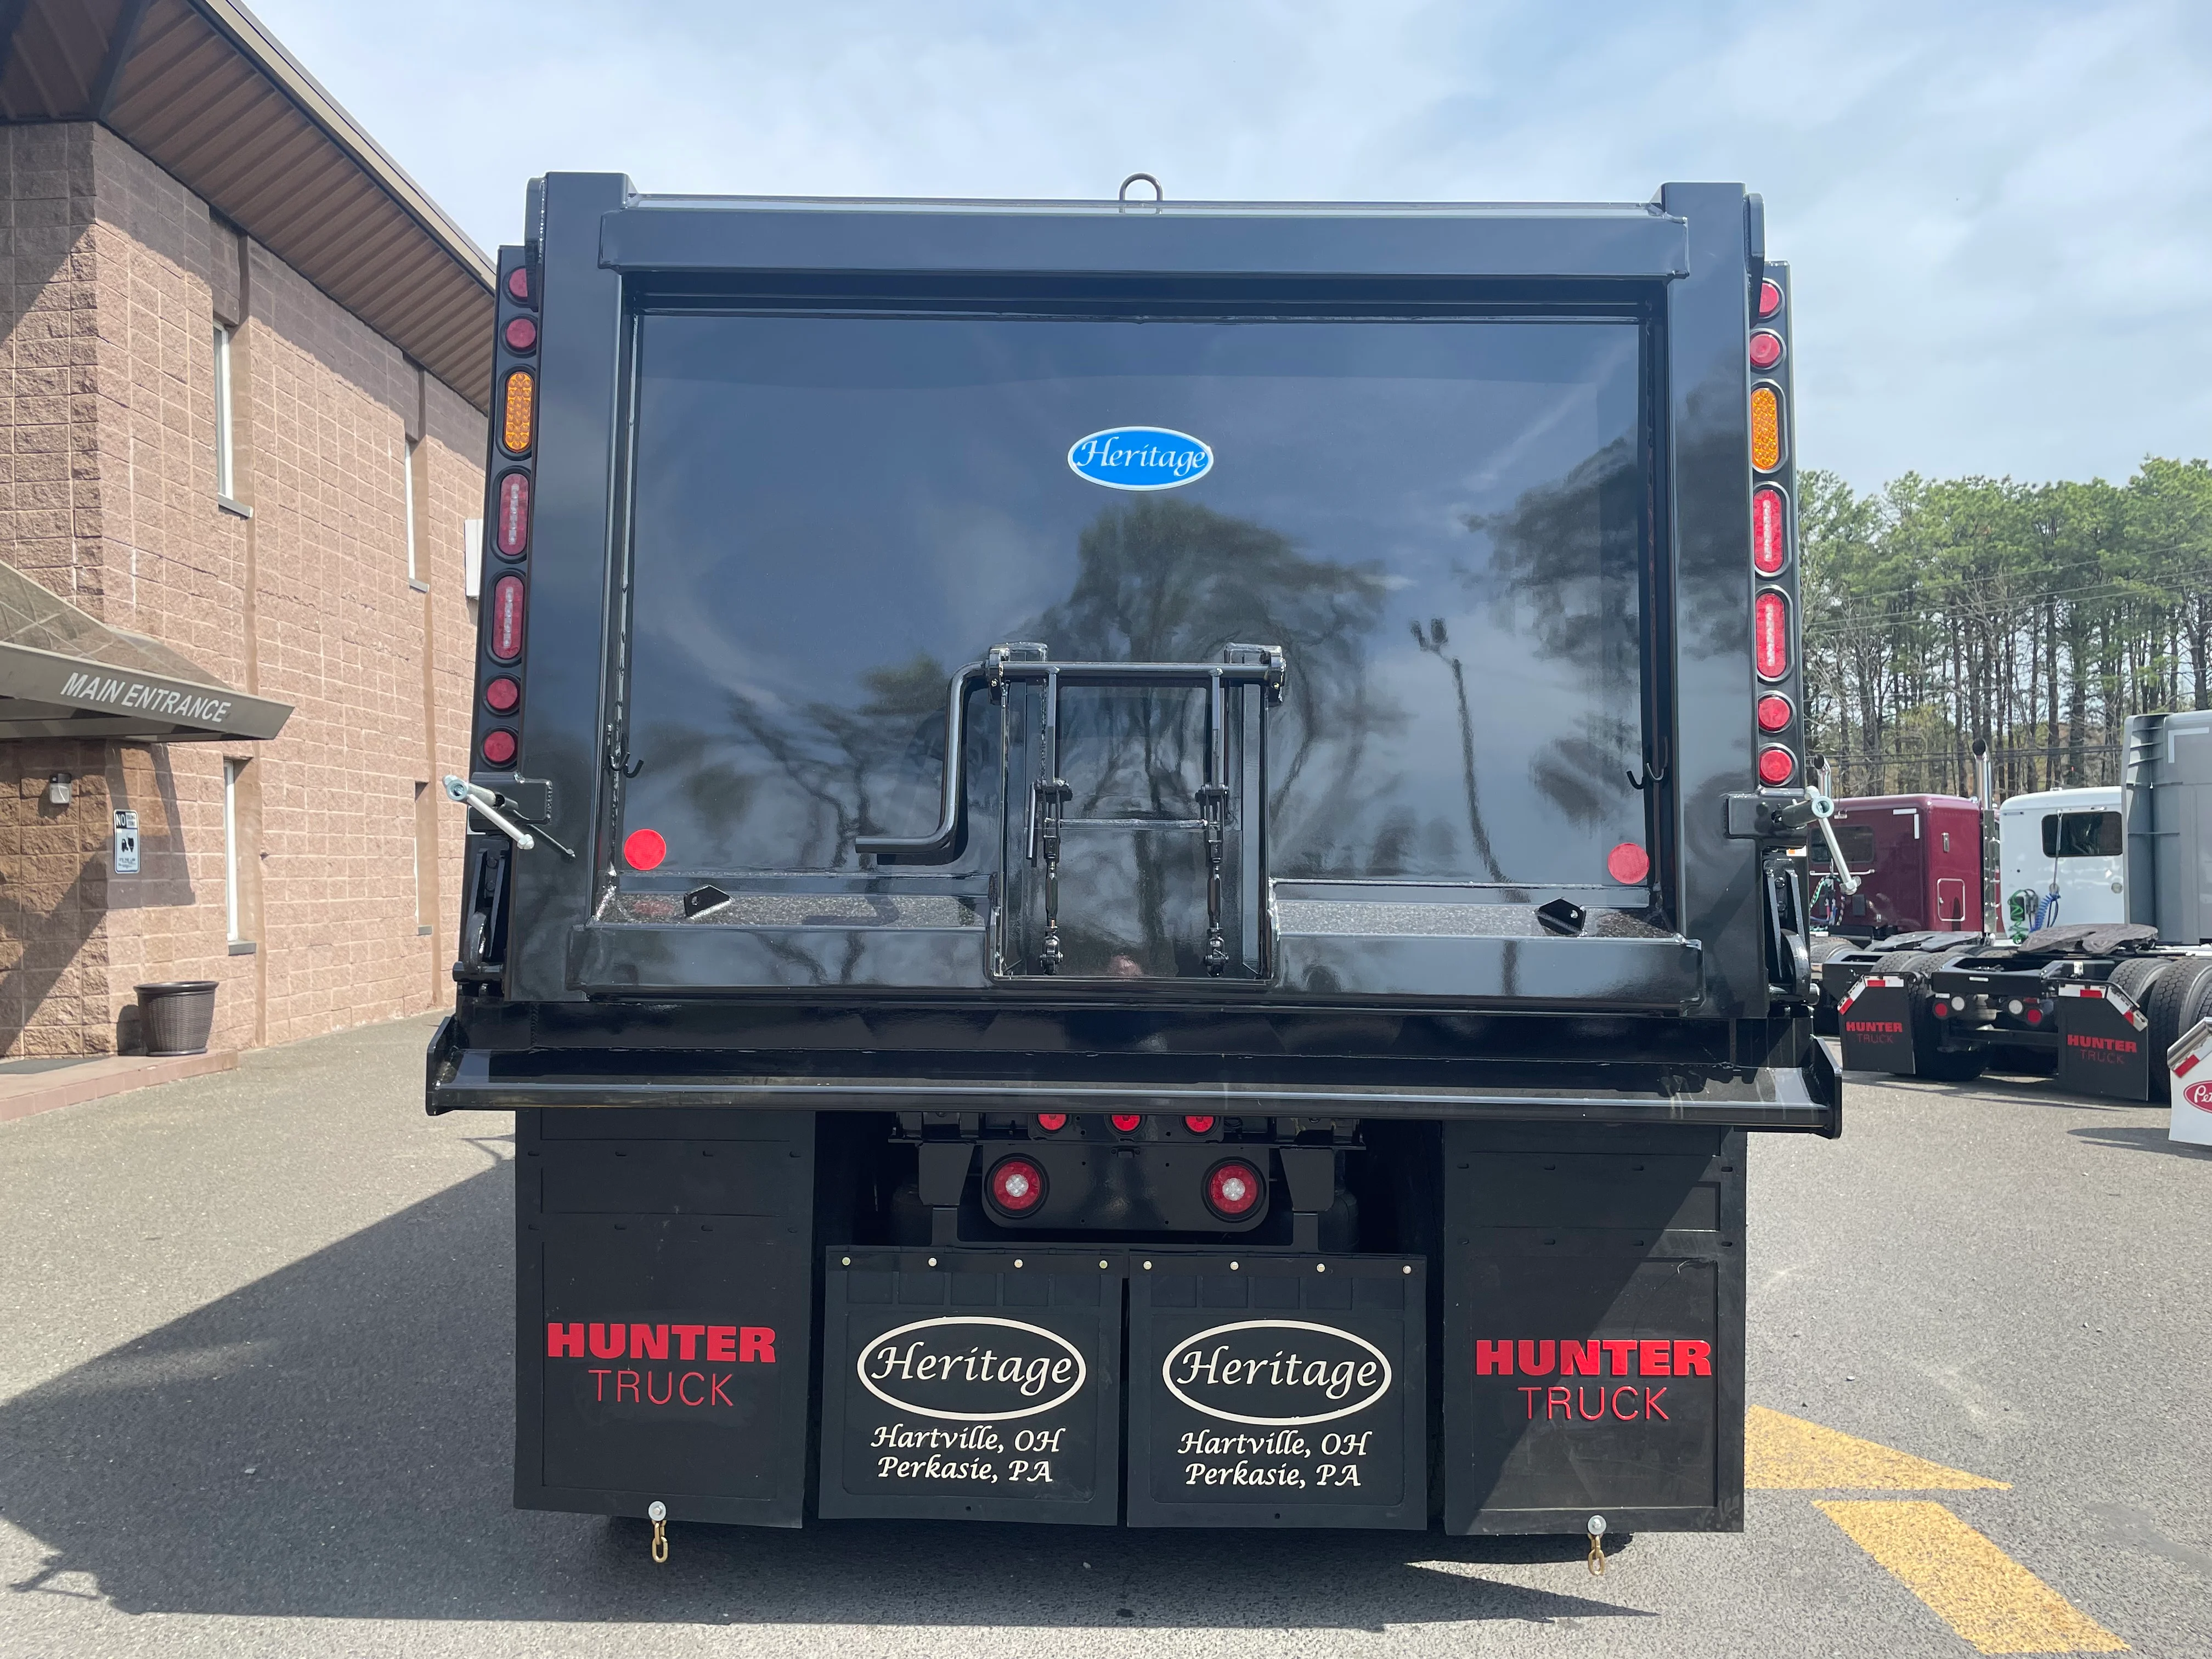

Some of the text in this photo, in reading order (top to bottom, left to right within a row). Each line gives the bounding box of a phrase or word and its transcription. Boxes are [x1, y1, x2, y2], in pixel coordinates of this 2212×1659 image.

[1076, 436, 1205, 476] Heritage
[60, 672, 232, 723] MAIN ENTRANCE
[116, 814, 126, 826] NO
[1846, 1021, 1903, 1032] HUNTER
[1857, 1034, 1893, 1043] TRUCK
[2067, 1034, 2137, 1053] HUNTER
[2080, 1049, 2125, 1064] TRUCK
[548, 1322, 777, 1363] HUNTER
[1476, 1339, 1712, 1376] HUNTER
[871, 1341, 1072, 1396] Heritage
[1176, 1345, 1378, 1400] Heritage
[588, 1369, 733, 1407] TRUCK
[1517, 1386, 1669, 1421] TRUCK
[870, 1423, 1066, 1454] Hartville, OH
[1177, 1429, 1373, 1458] Hartville, OH
[878, 1454, 1053, 1483] Perkasie, PA
[1185, 1460, 1361, 1489] Perkasie, PA
